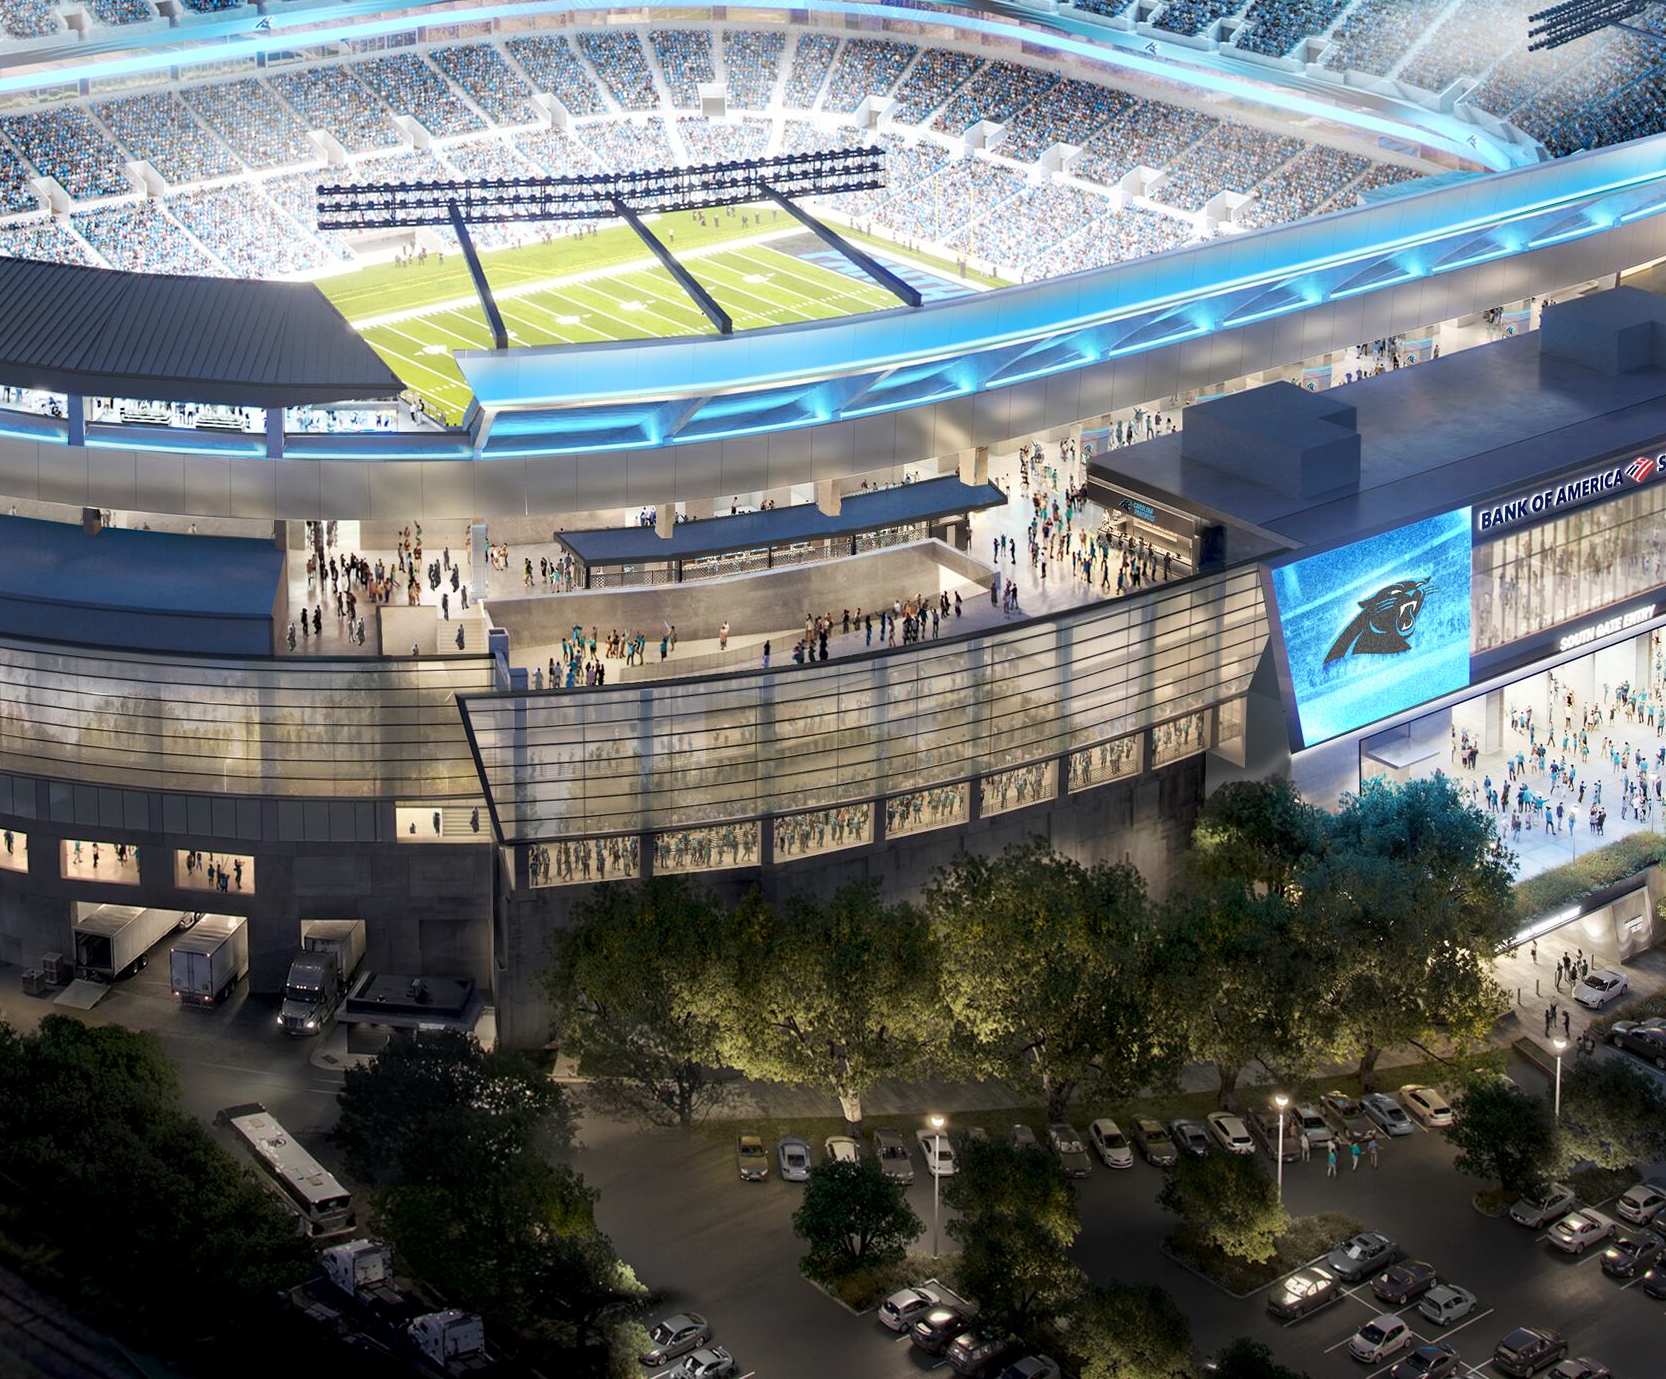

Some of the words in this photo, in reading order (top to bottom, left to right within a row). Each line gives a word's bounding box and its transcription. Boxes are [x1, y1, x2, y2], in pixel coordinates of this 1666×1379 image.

[1479, 499, 1529, 531] BANK
[1531, 492, 1553, 513] OF
[1555, 469, 1624, 506] AMERICA
[1560, 626, 1595, 652] SOUTH
[1596, 616, 1623, 638] GATE
[1623, 604, 1656, 629] ENTRY
